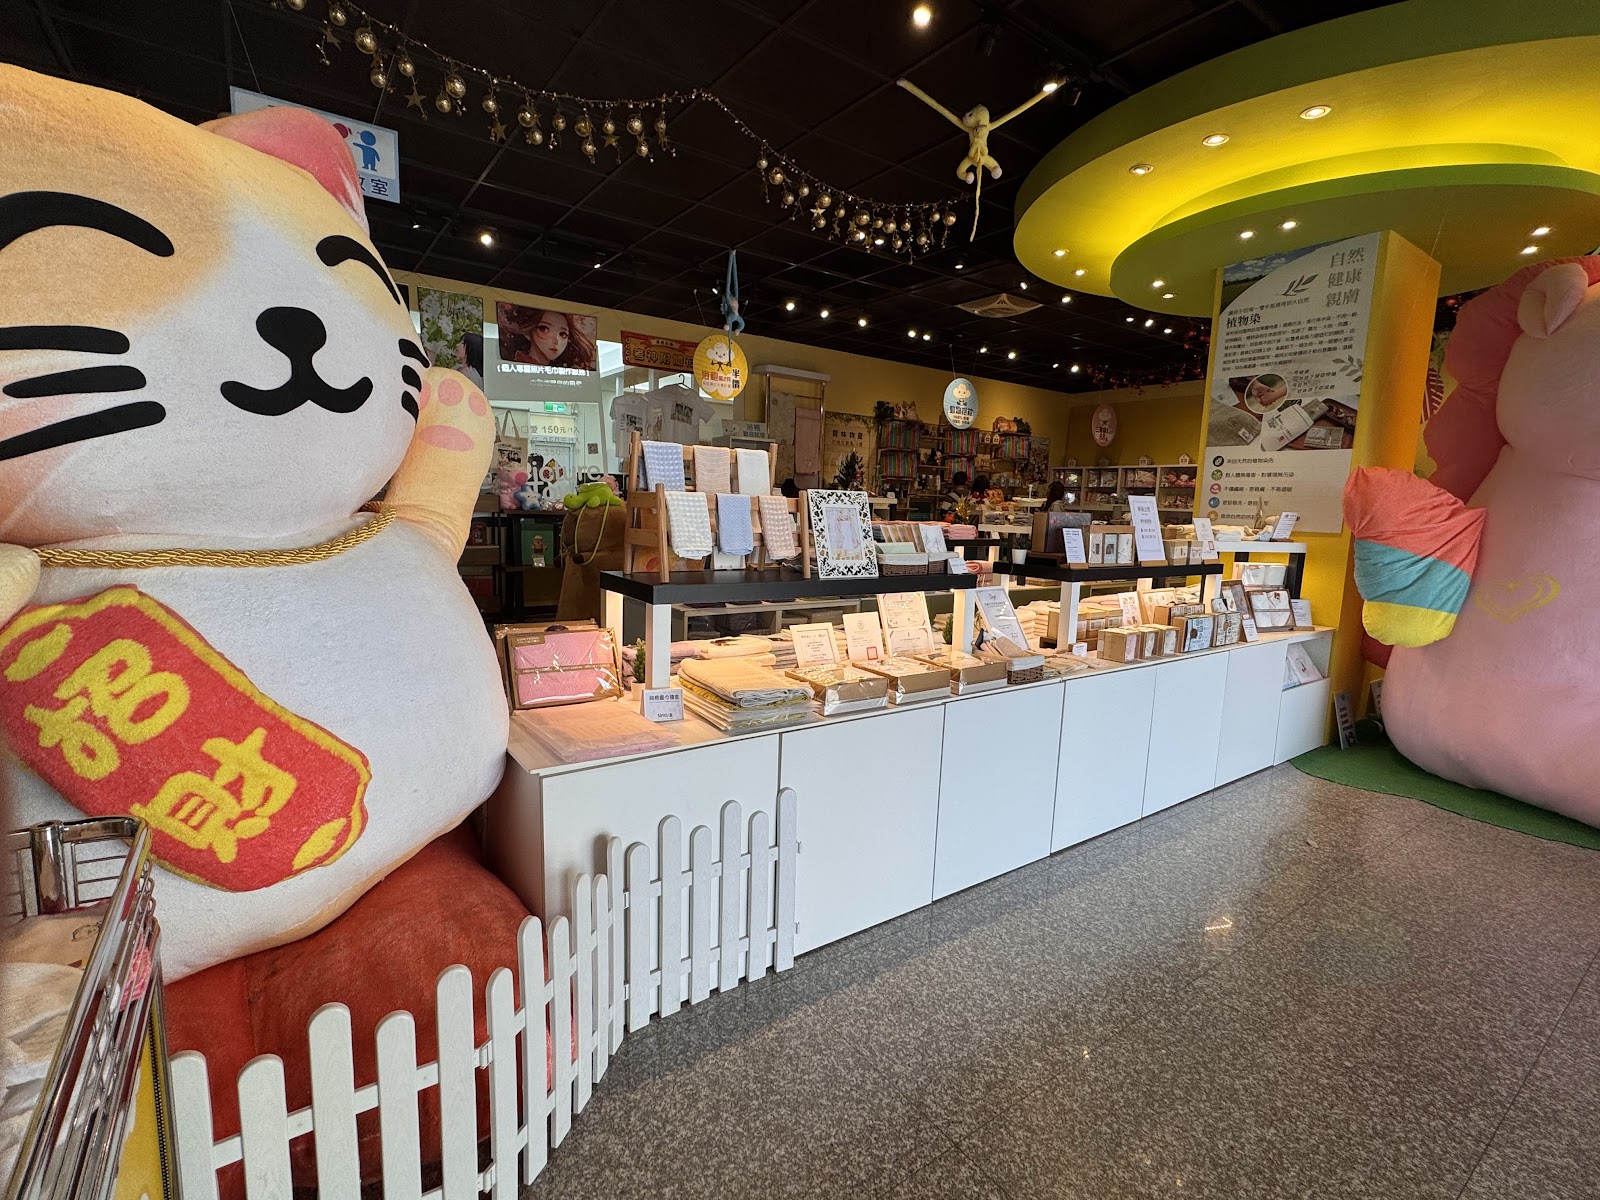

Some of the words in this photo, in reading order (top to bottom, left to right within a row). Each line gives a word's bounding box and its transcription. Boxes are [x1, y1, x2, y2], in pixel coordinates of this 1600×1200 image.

[360, 177, 389, 197] 室
[1330, 247, 1365, 268] 自然
[1327, 268, 1362, 288] 健康
[1325, 288, 1360, 308] 親膚
[1225, 313, 1261, 329] 植物染
[732, 368, 740, 389] 半價
